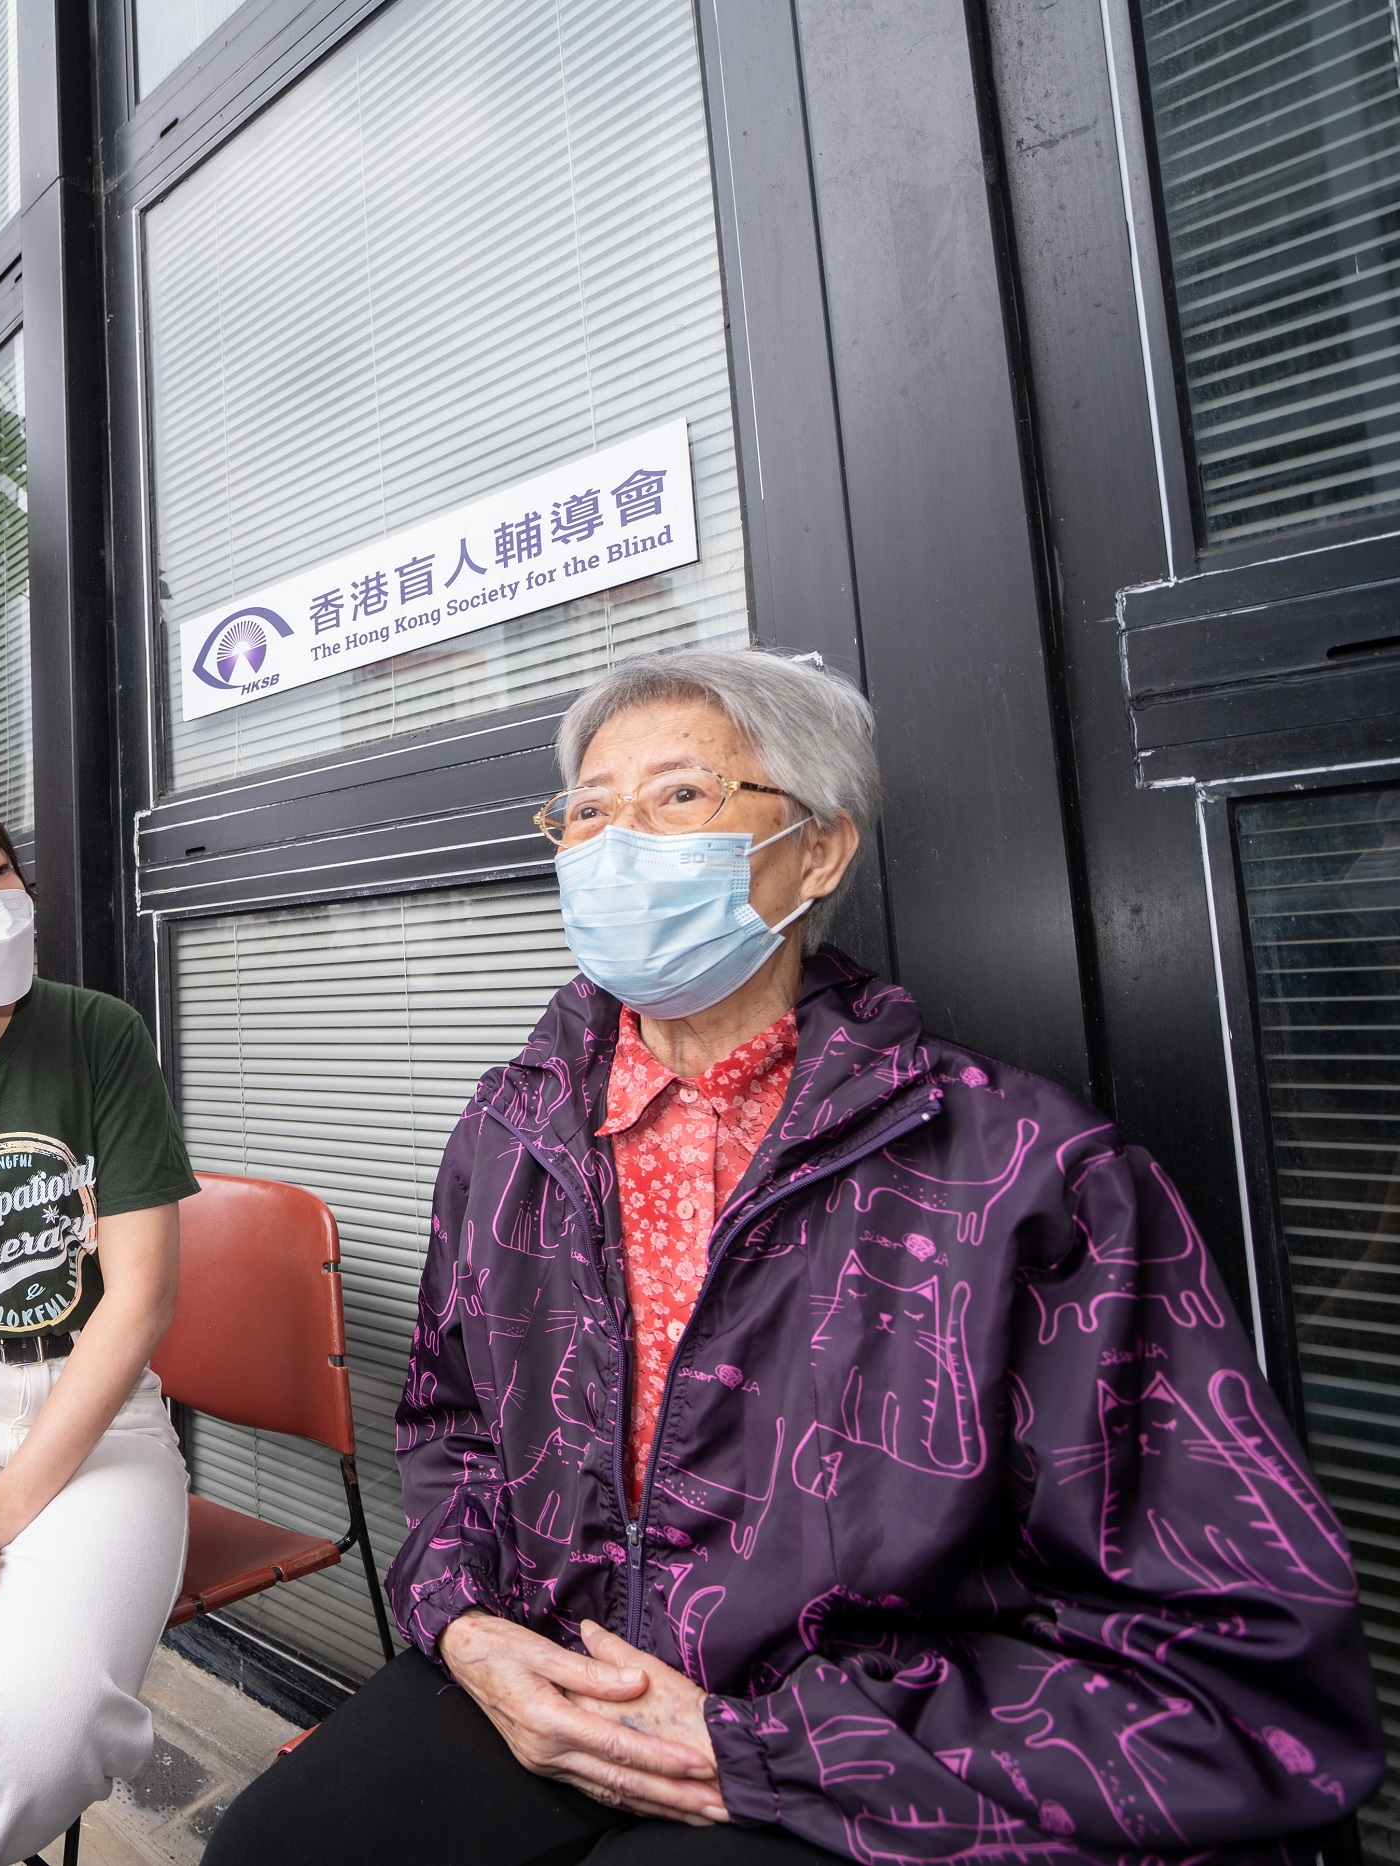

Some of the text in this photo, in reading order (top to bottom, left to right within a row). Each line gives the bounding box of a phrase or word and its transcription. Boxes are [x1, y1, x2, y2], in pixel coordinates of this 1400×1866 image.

[309, 468, 668, 635] 香港盲人輔導會
[311, 525, 674, 662] The Hong Kong Society for the Blind
[240, 673, 280, 696] HKSB
[25, 1283, 46, 1301] &
